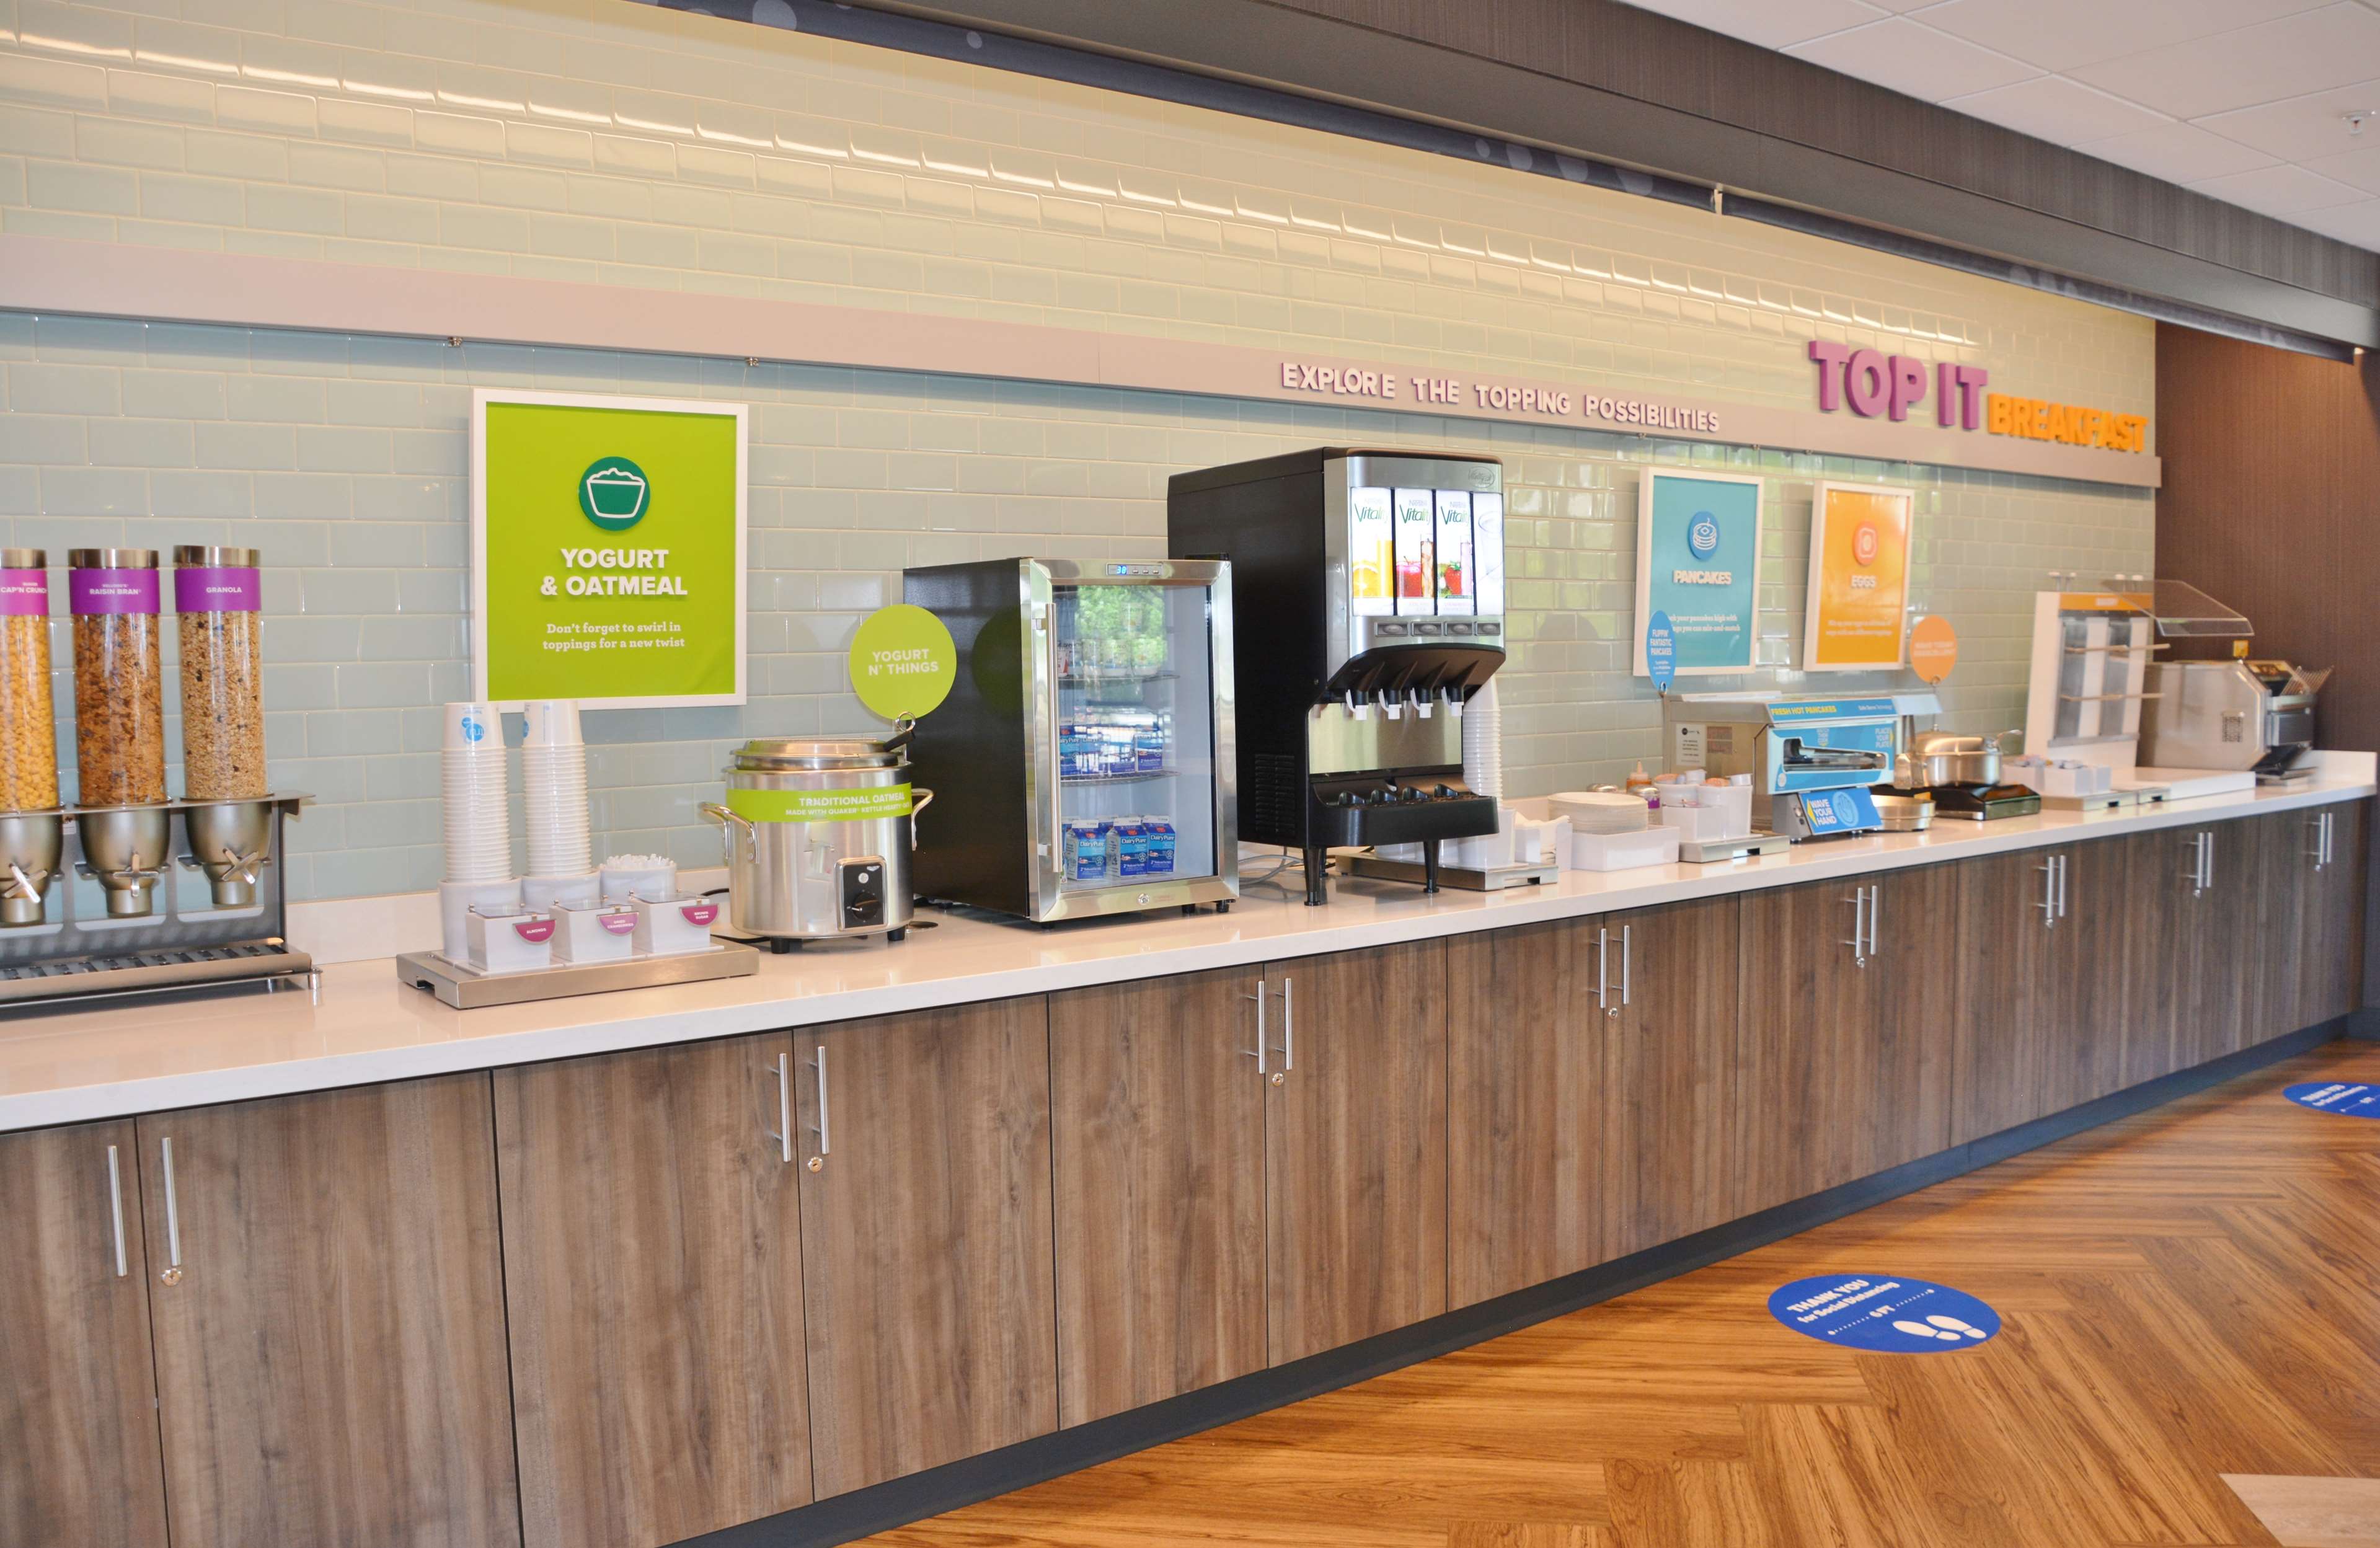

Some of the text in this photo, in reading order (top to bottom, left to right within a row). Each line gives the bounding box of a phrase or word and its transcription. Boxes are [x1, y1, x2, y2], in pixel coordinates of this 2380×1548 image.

[1808, 340, 1988, 430] TOP IT
[1281, 361, 1720, 432] EXPLORE THE TOPPING POSSIBILITIES
[1988, 392, 2149, 453] BREAKFAST
[1399, 504, 1432, 525] Vitality
[560, 548, 669, 568] YOGURT
[1673, 570, 1732, 585] PANCAKES
[1851, 575, 1877, 587] EGGS
[541, 575, 688, 596] & OATMEAL
[546, 621, 681, 635] Don't forget to swirl in
[542, 639, 597, 652] toppings
[599, 638, 617, 648] for
[629, 639, 653, 648] new
[655, 637, 685, 647] twist
[872, 648, 930, 663] YOGURT
[868, 661, 939, 676] N' THINGS
[1771, 705, 1837, 715] FRESH HOT PANCAKES
[872, 792, 905, 803] OATMEAL
[1810, 798, 1830, 808] WAVE
[1814, 807, 1834, 817] YOUR
[1816, 816, 1838, 826] HAND
[1786, 1278, 1870, 1312] THANK YOU
[1813, 1301, 1850, 1317] Social
[1841, 1281, 1901, 1305] Distancing
[1875, 1304, 1896, 1315] FT
